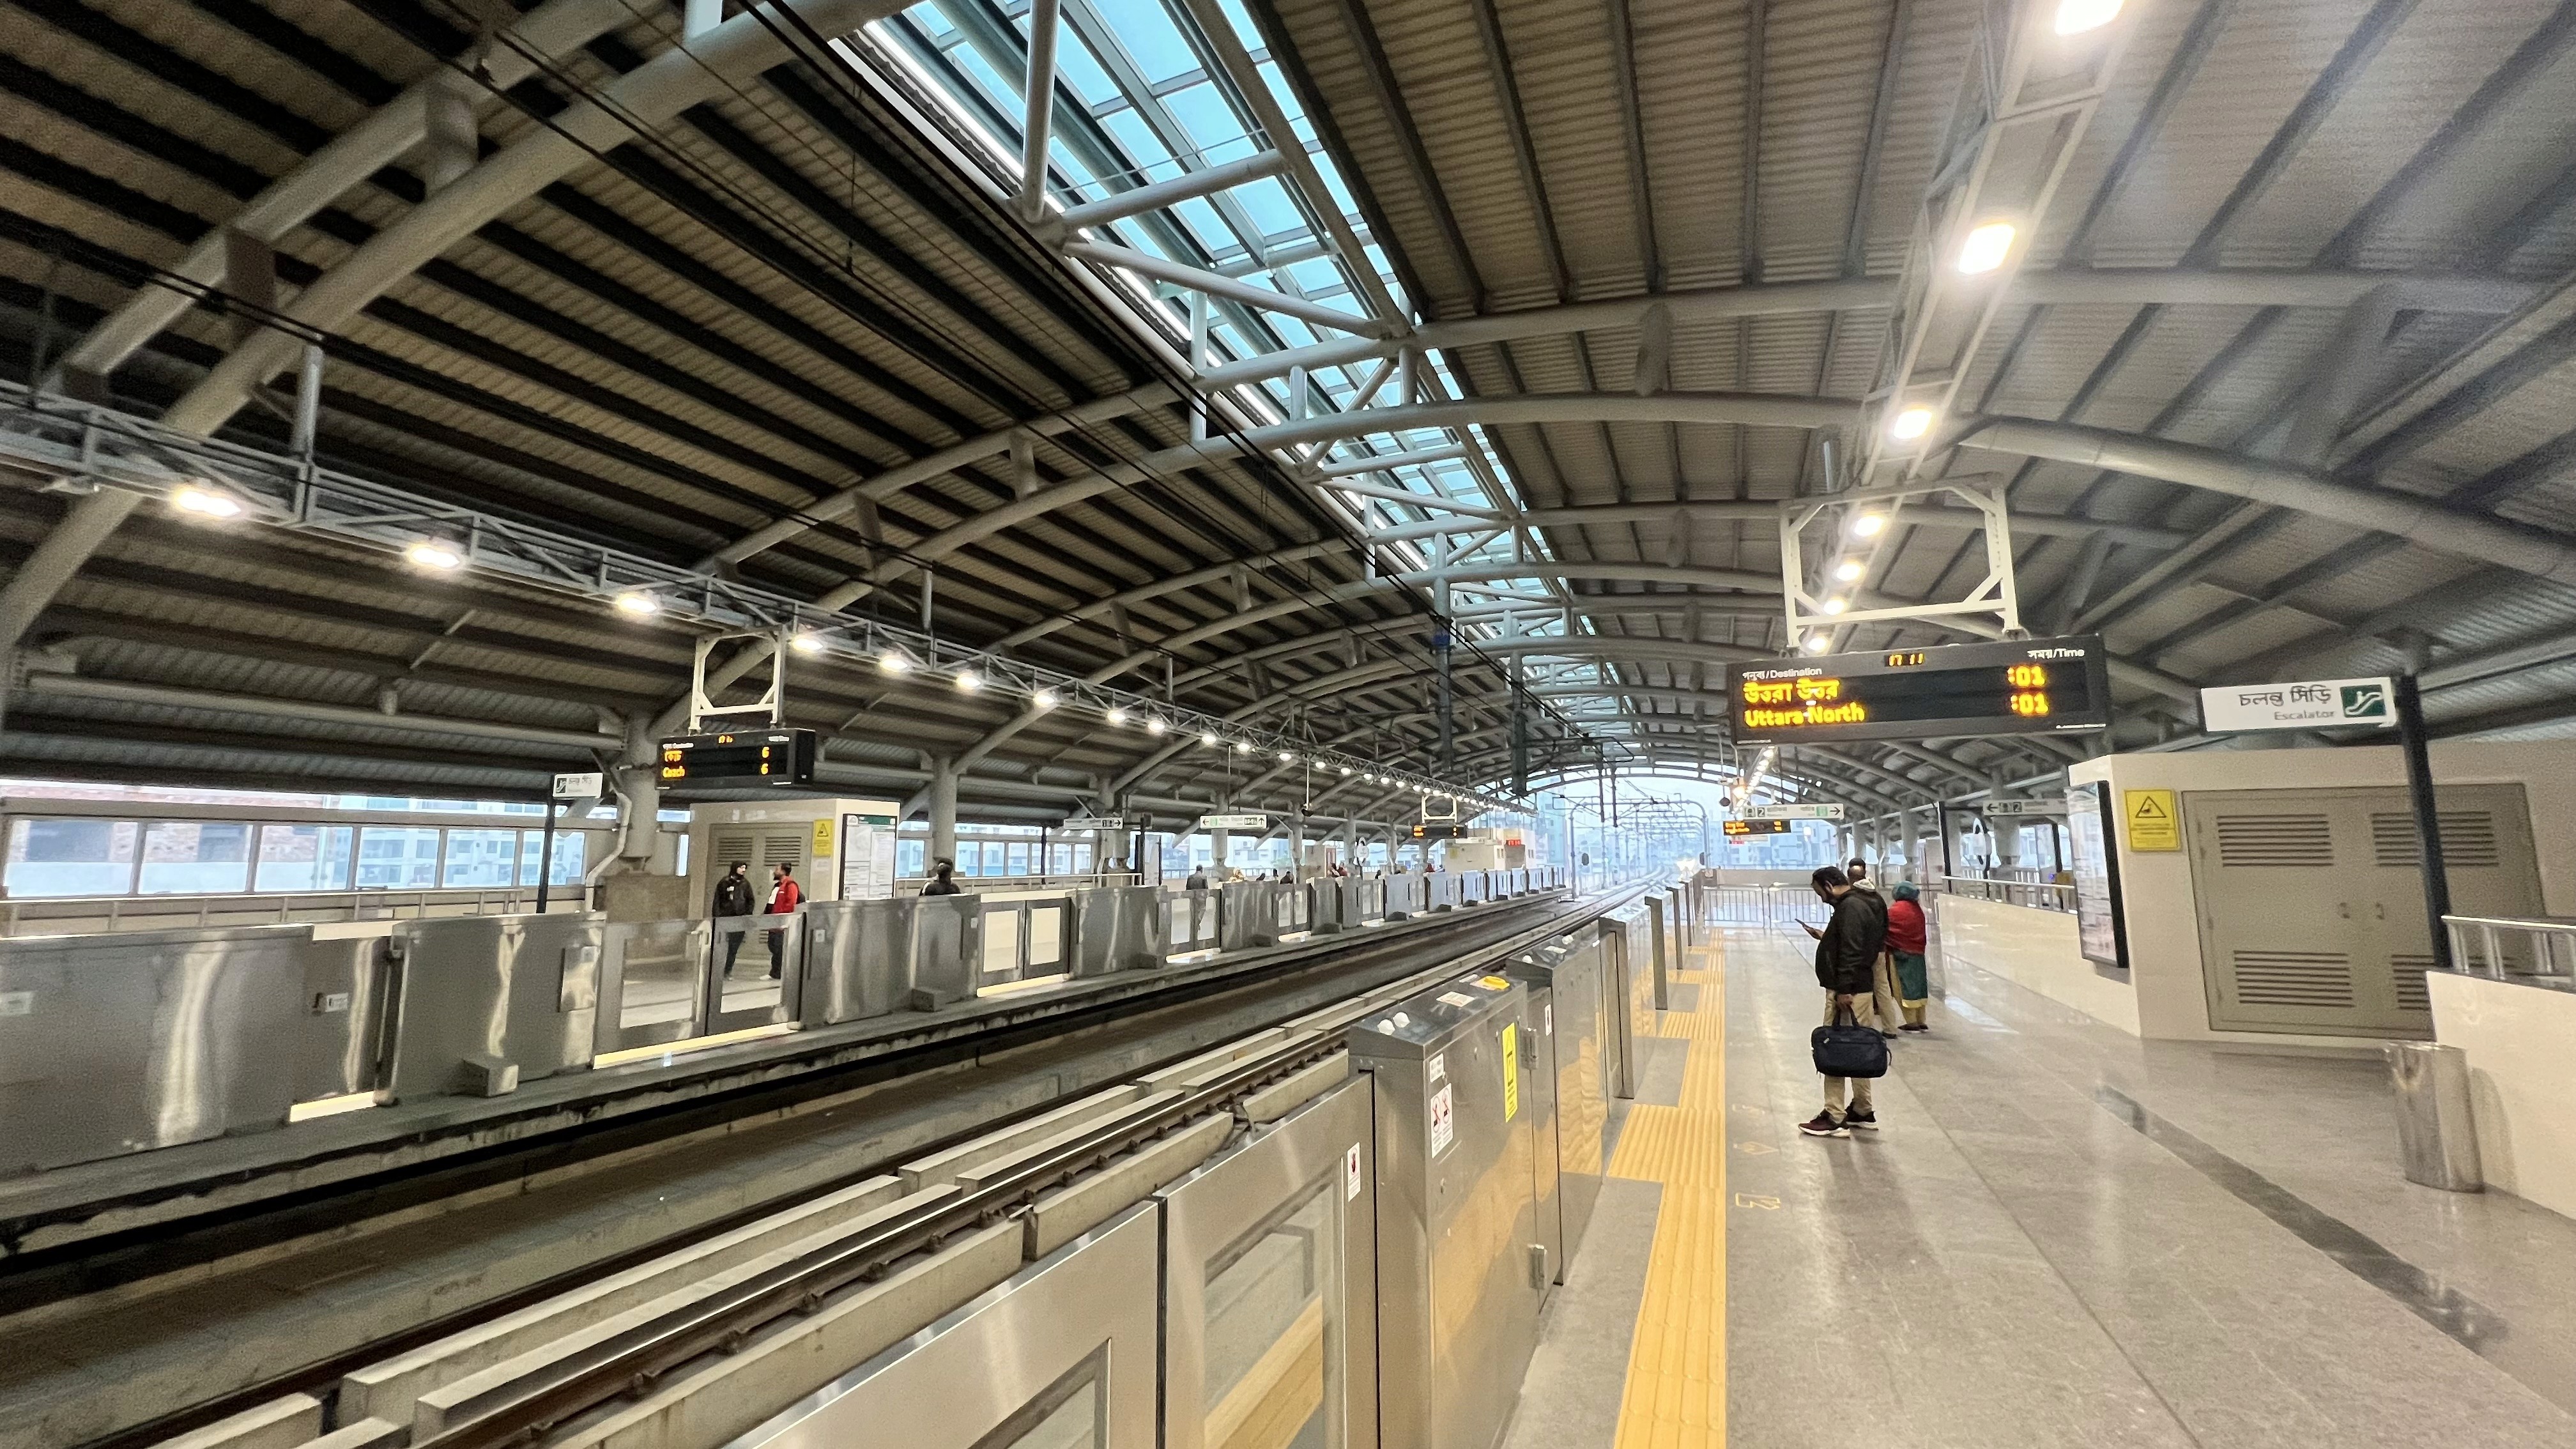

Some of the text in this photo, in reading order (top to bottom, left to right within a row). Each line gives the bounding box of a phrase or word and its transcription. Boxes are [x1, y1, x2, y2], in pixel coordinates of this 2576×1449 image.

[2238, 691, 2284, 707] চলন্ত
[1744, 702, 1865, 728] Uttara North
[2274, 710, 2335, 720] Escalator
